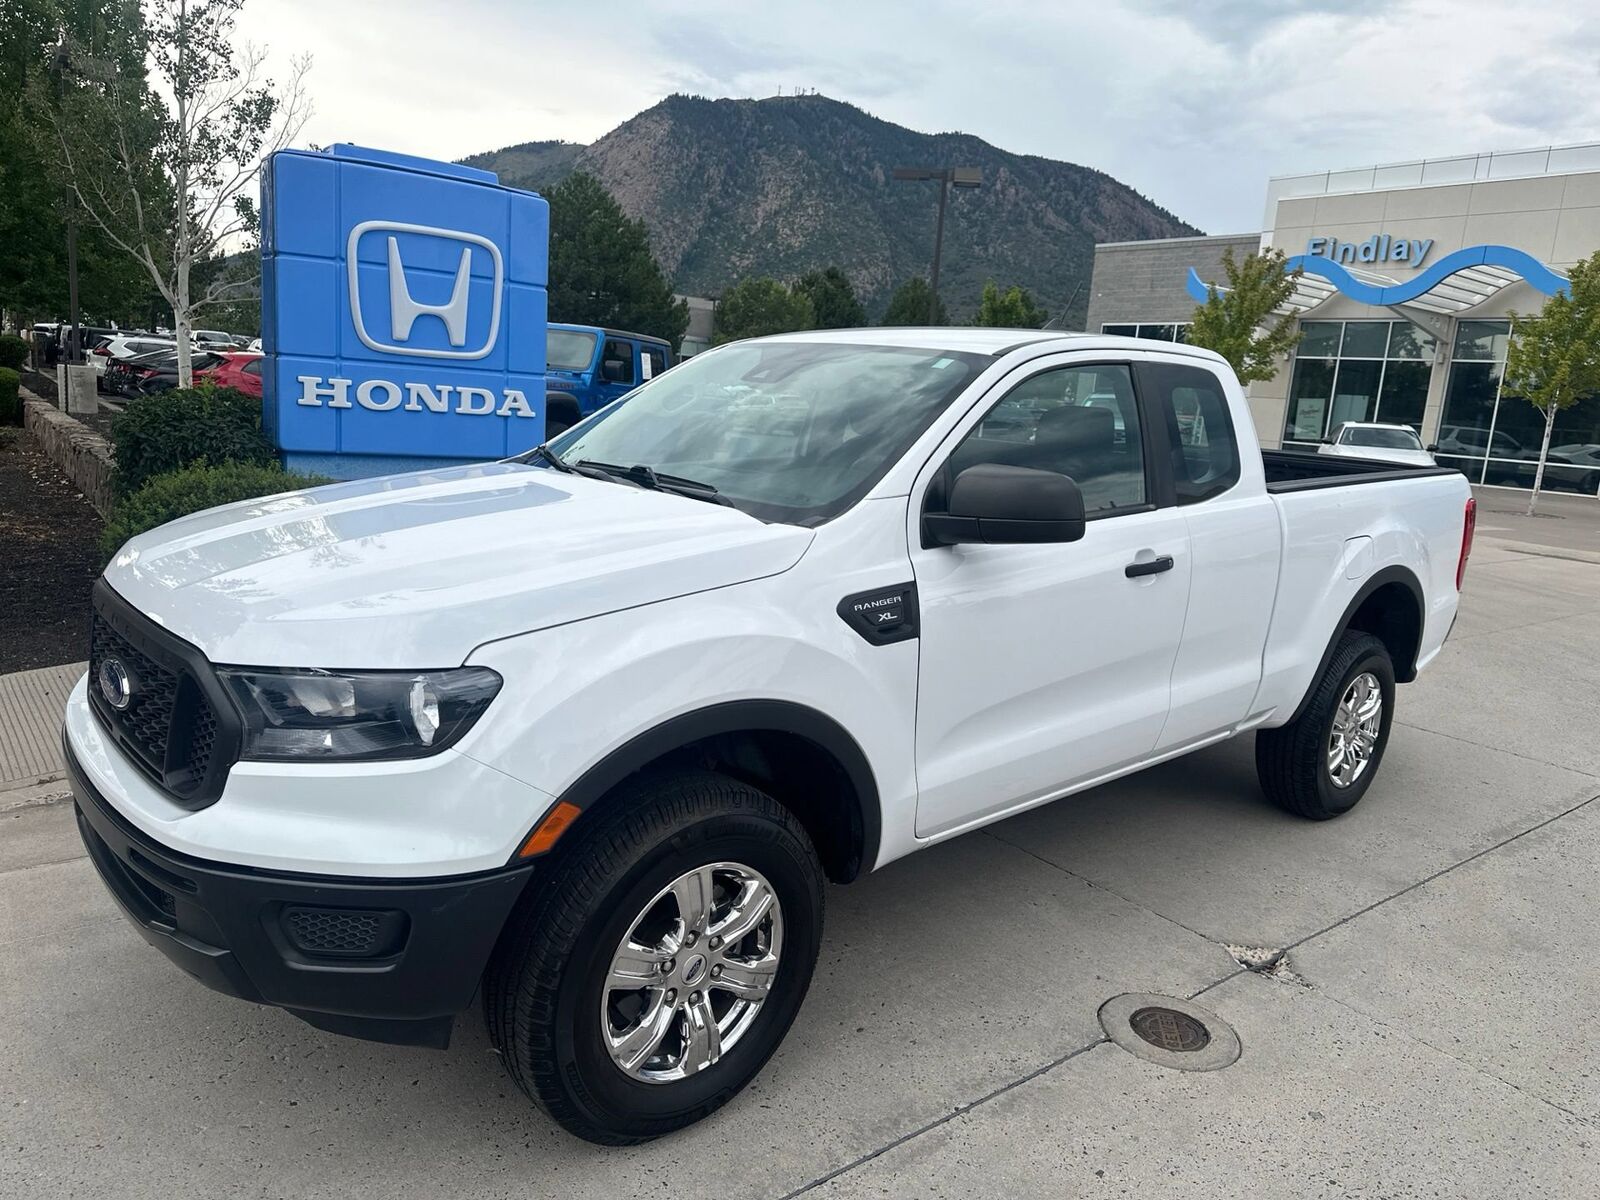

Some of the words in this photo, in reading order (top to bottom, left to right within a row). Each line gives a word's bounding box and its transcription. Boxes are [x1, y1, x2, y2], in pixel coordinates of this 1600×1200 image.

[1306, 232, 1434, 268] Findlay
[297, 375, 536, 418] HONDA
[854, 595, 902, 611] RANGER
[878, 612, 898, 622] XL
